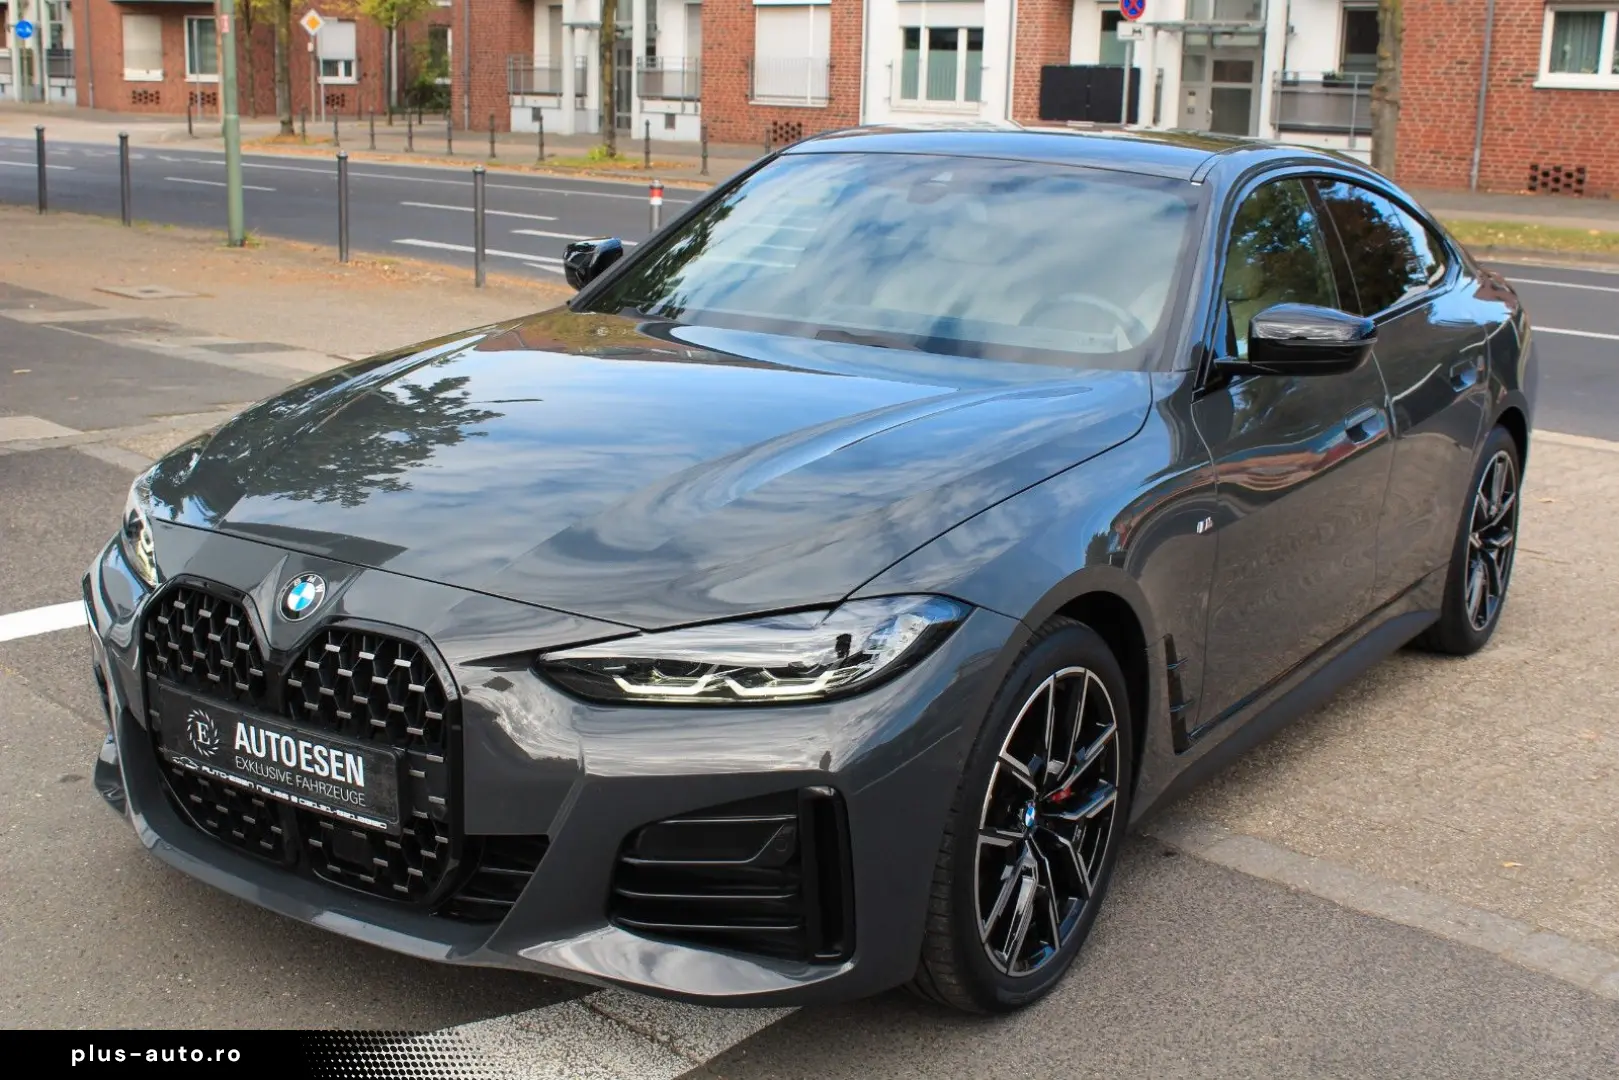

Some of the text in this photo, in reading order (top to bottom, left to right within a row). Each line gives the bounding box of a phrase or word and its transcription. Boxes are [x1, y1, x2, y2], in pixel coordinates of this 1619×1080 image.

[196, 721, 211, 745] E
[235, 755, 366, 807] EXKLUSIVE FAHRZEUGE
